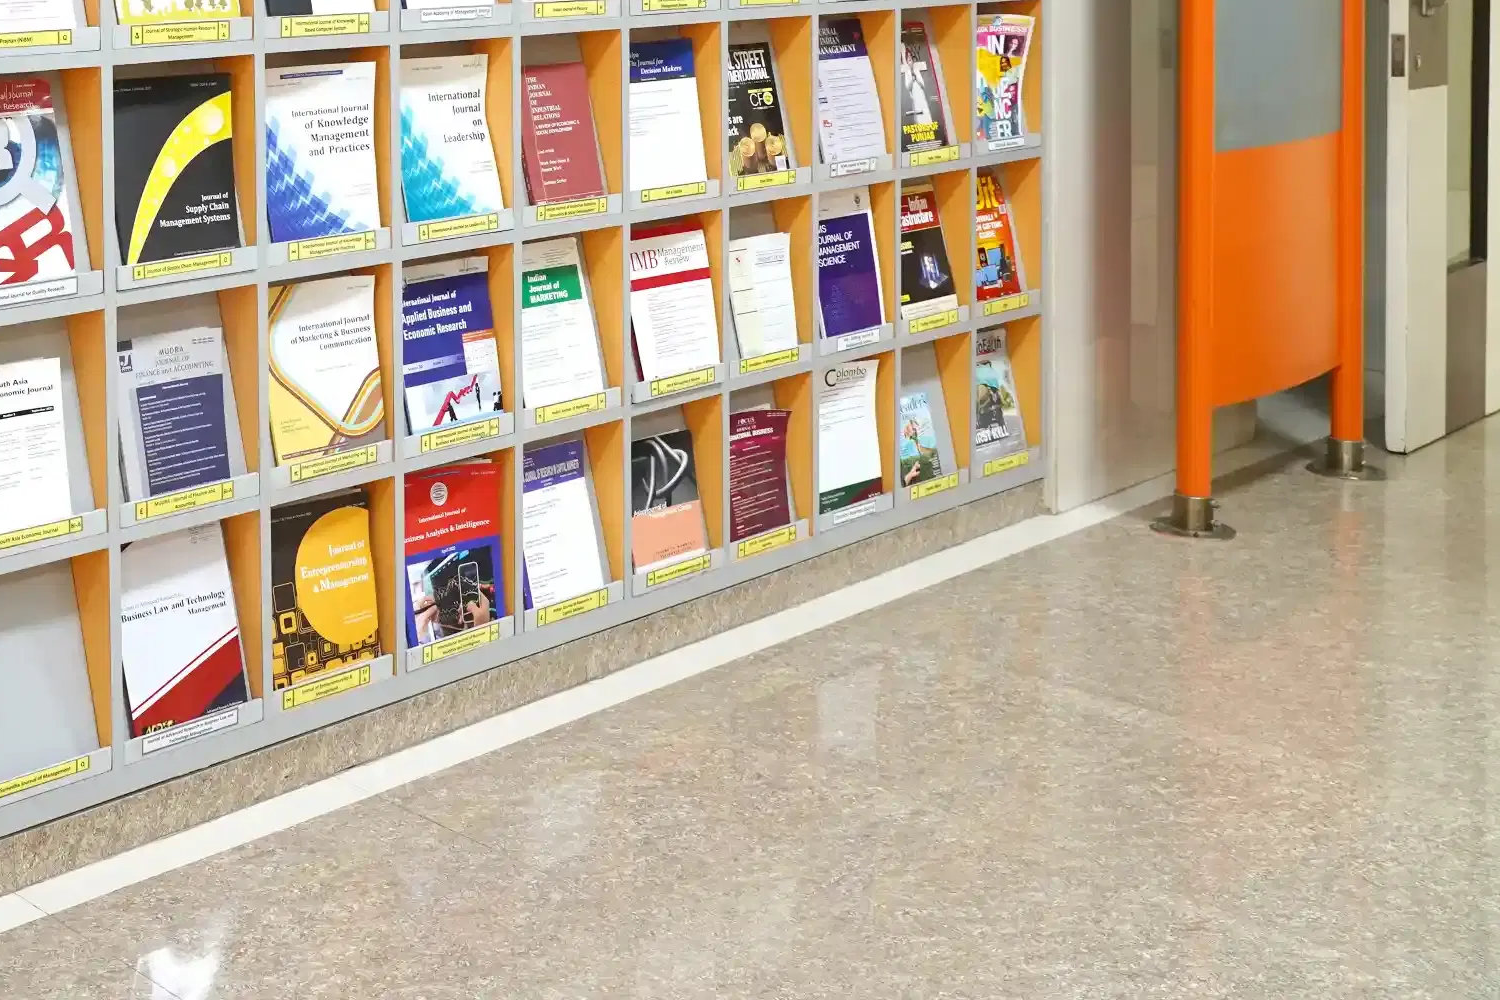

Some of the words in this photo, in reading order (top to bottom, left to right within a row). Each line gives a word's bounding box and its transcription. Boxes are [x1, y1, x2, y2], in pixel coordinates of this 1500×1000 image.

[820, 36, 840, 45] INDIAN
[734, 50, 764, 69] STREET
[640, 67, 661, 75] Decision
[662, 66, 682, 74] Makers
[8, 90, 33, 100] Journal
[428, 89, 480, 102] International
[4, 101, 33, 110] Research
[291, 106, 340, 118] International
[340, 104, 370, 114] Journal
[452, 103, 480, 116] Journal
[304, 120, 314, 130] of
[317, 115, 369, 128] Knowledge
[903, 123, 925, 134] PASTORS
[926, 122, 938, 130] OF
[310, 128, 370, 144] Management
[444, 131, 486, 144] Leadership
[911, 132, 935, 142] PUNJAB
[202, 193, 221, 202] Journal
[908, 196, 928, 212] Indian
[186, 204, 208, 214] Supply
[210, 202, 229, 210] Chain
[160, 216, 202, 228] Management
[203, 212, 230, 224] Systems
[664, 255, 690, 266] Review
[819, 256, 846, 268] SCIENCE
[530, 290, 568, 304] MARKETING
[401, 308, 426, 324] Applied
[428, 304, 458, 319] Business
[458, 300, 472, 313] and
[298, 318, 342, 332] International
[344, 314, 370, 326] Journal
[290, 336, 298, 346] of
[299, 332, 332, 344] Marketing
[341, 325, 370, 336] Business
[404, 327, 436, 341] Economic
[436, 320, 467, 334] Research
[320, 336, 372, 350] Communication
[12, 378, 28, 387] Asia
[26, 384, 53, 396] Journal
[738, 416, 755, 426] FOCUS
[418, 512, 445, 523] International
[446, 508, 460, 520] Journal
[21, 532, 40, 541] Economic
[40, 527, 58, 537] Journal
[328, 541, 355, 556] Journal
[356, 540, 364, 549] of
[300, 556, 368, 580] Entrepreneurship
[121, 608, 152, 624] Business
[154, 603, 169, 616] Law
[171, 600, 184, 611] and
[186, 589, 226, 608] Technology
[0, 783, 20, 792] Sumedha
[21, 778, 36, 788] Journal
[43, 766, 71, 780] Management
